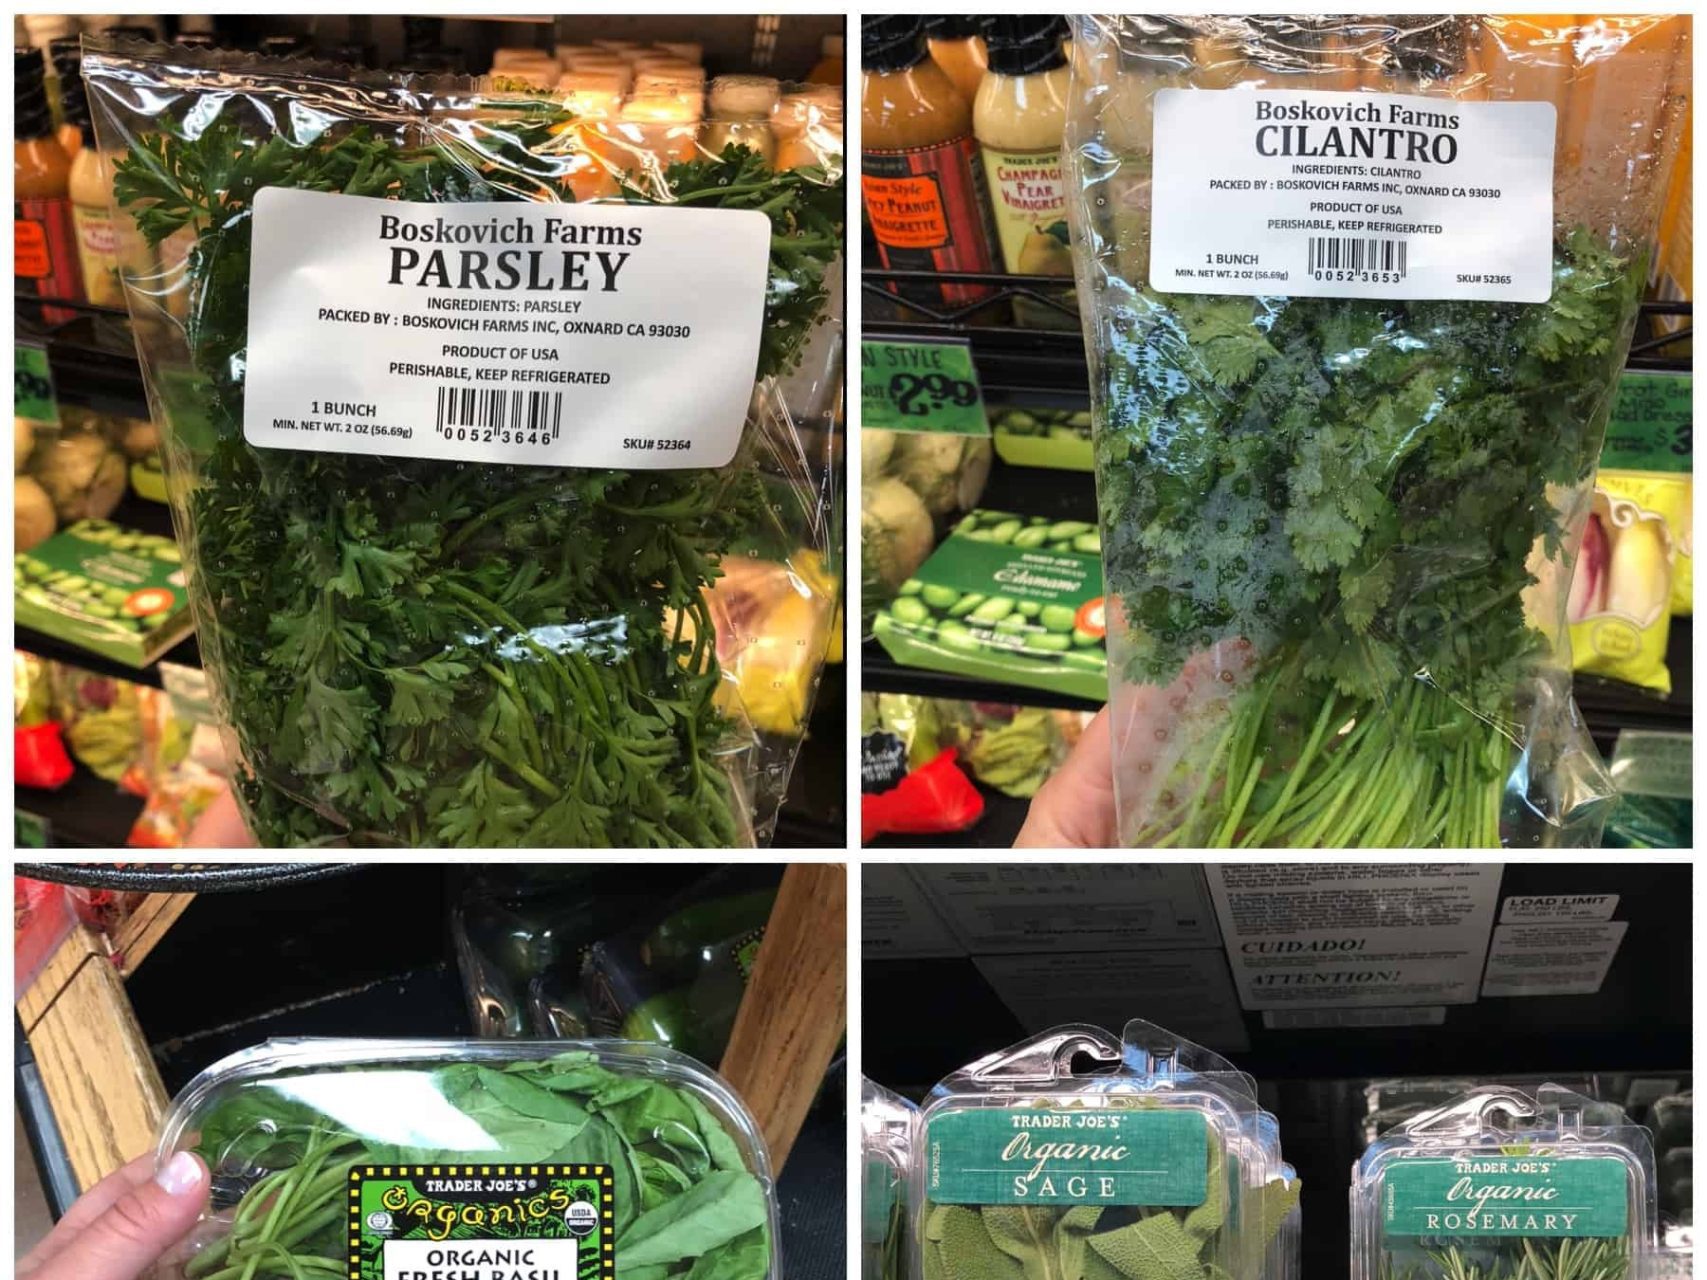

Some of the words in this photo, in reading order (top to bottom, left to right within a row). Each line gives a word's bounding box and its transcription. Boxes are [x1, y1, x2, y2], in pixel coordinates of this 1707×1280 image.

[1256, 100, 1381, 122] Boskovich
[1388, 104, 1460, 130] Farms
[1255, 125, 1458, 165] CILANTRO
[1292, 164, 1368, 176] INGREDIENTS:
[1370, 166, 1421, 180] CILANTRO
[1016, 182, 1053, 197] PEAR
[1209, 179, 1251, 190] PACKED
[1253, 180, 1267, 190] BY
[1276, 180, 1340, 191] BOSKOVICH
[1342, 181, 1380, 192] FARMS
[1382, 183, 1402, 196] INC,
[1405, 184, 1450, 197] OXNARD
[1452, 187, 1466, 198] CA
[1468, 188, 1501, 199] 93030
[1310, 202, 1362, 213] PRODUCT
[1364, 203, 1380, 214] OF
[1381, 204, 1403, 215] USA
[379, 214, 534, 244] Boskovich
[543, 217, 642, 246] Farms
[1267, 219, 1335, 231] PERISHABLE,
[1338, 220, 1364, 230] KEEP
[1366, 221, 1443, 234] REFRIGERATED
[1216, 254, 1259, 265] BUNCH
[387, 246, 630, 292] PARSLEY
[1175, 269, 1196, 278] MIN.
[1198, 269, 1215, 278] NET
[1216, 270, 1233, 279] WT.
[1241, 270, 1253, 279] OZ
[1254, 270, 1289, 281] (56.69g)
[1456, 274, 1482, 283] SKU#
[1483, 275, 1512, 284] 52365
[427, 297, 520, 313] INGREDIENTS:
[523, 300, 582, 314] PARSLEY
[318, 308, 370, 323] PACKED
[373, 310, 391, 325] BY
[402, 314, 479, 331] BOSKOVICH
[482, 317, 529, 333] FARMS
[532, 320, 560, 335] INC,
[563, 320, 623, 335] OXNARD
[627, 323, 645, 336] CA
[649, 324, 691, 338] 93030
[442, 344, 505, 359] PRODUCT
[509, 347, 528, 360] OF
[531, 347, 559, 361] USA
[885, 347, 942, 369] STYLE
[389, 362, 472, 381] PERISHABLE,
[475, 368, 508, 381] KEEP
[511, 369, 611, 385] REFRIGERATED
[311, 401, 319, 414] 1
[323, 402, 377, 418] BUNCH
[273, 418, 299, 430] MIN.
[301, 420, 323, 431] NET
[324, 422, 343, 433] WT.
[354, 424, 370, 434] OZ
[371, 425, 413, 439] (56.69g)
[623, 437, 654, 449] SKU#
[656, 439, 691, 450] 52364
[1510, 898, 1557, 906] LOAD
[1561, 896, 1608, 905] LIMIT
[1241, 938, 1366, 954] CUIDADO!
[1251, 970, 1401, 986] ATTENTION!
[1012, 1115, 1071, 1128] TRADER
[1076, 1115, 1120, 1128] JOE'S
[1001, 1132, 1131, 1182] Organic
[1455, 1163, 1509, 1173] TRADER
[1512, 1163, 1550, 1173] JOE'S
[426, 1179, 483, 1192] TRADER
[1014, 1176, 1116, 1197] SAGE
[1447, 1176, 1559, 1219] Organic
[382, 1186, 570, 1241] Organics
[1426, 1213, 1578, 1230] ROSEMARY
[426, 1249, 535, 1266] ORGANIC
